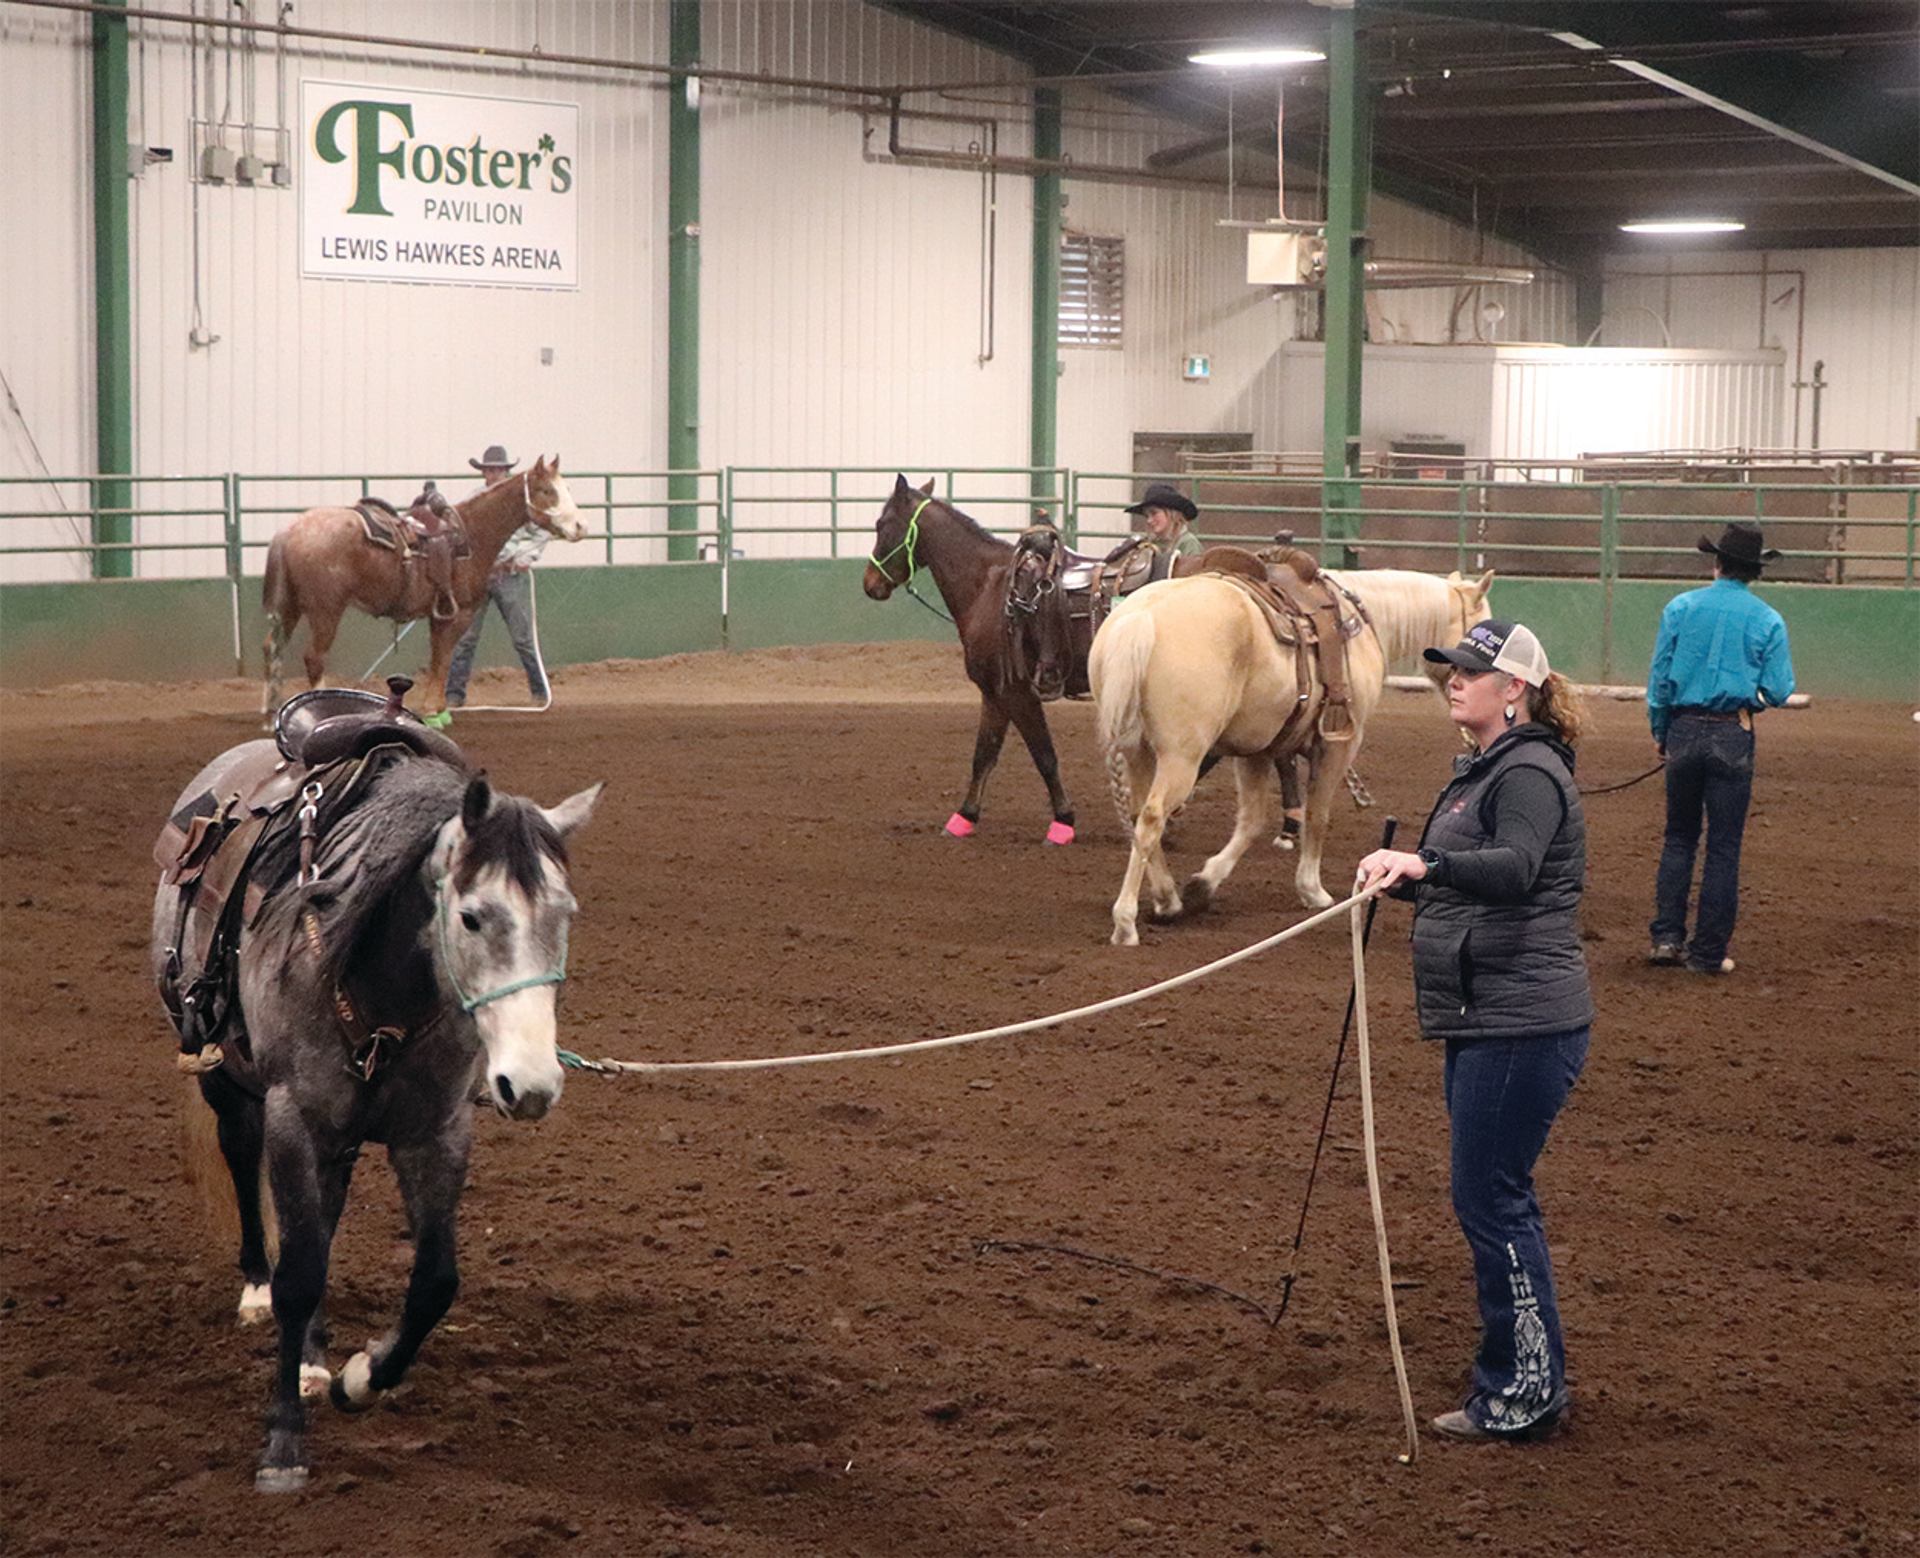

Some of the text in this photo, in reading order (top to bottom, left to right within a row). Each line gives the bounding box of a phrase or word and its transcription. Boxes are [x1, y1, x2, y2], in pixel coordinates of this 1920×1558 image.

[314, 99, 573, 217] Foster's
[424, 198, 523, 225] PAVILION
[321, 236, 562, 271] LEWIS HAWKES ARENA
